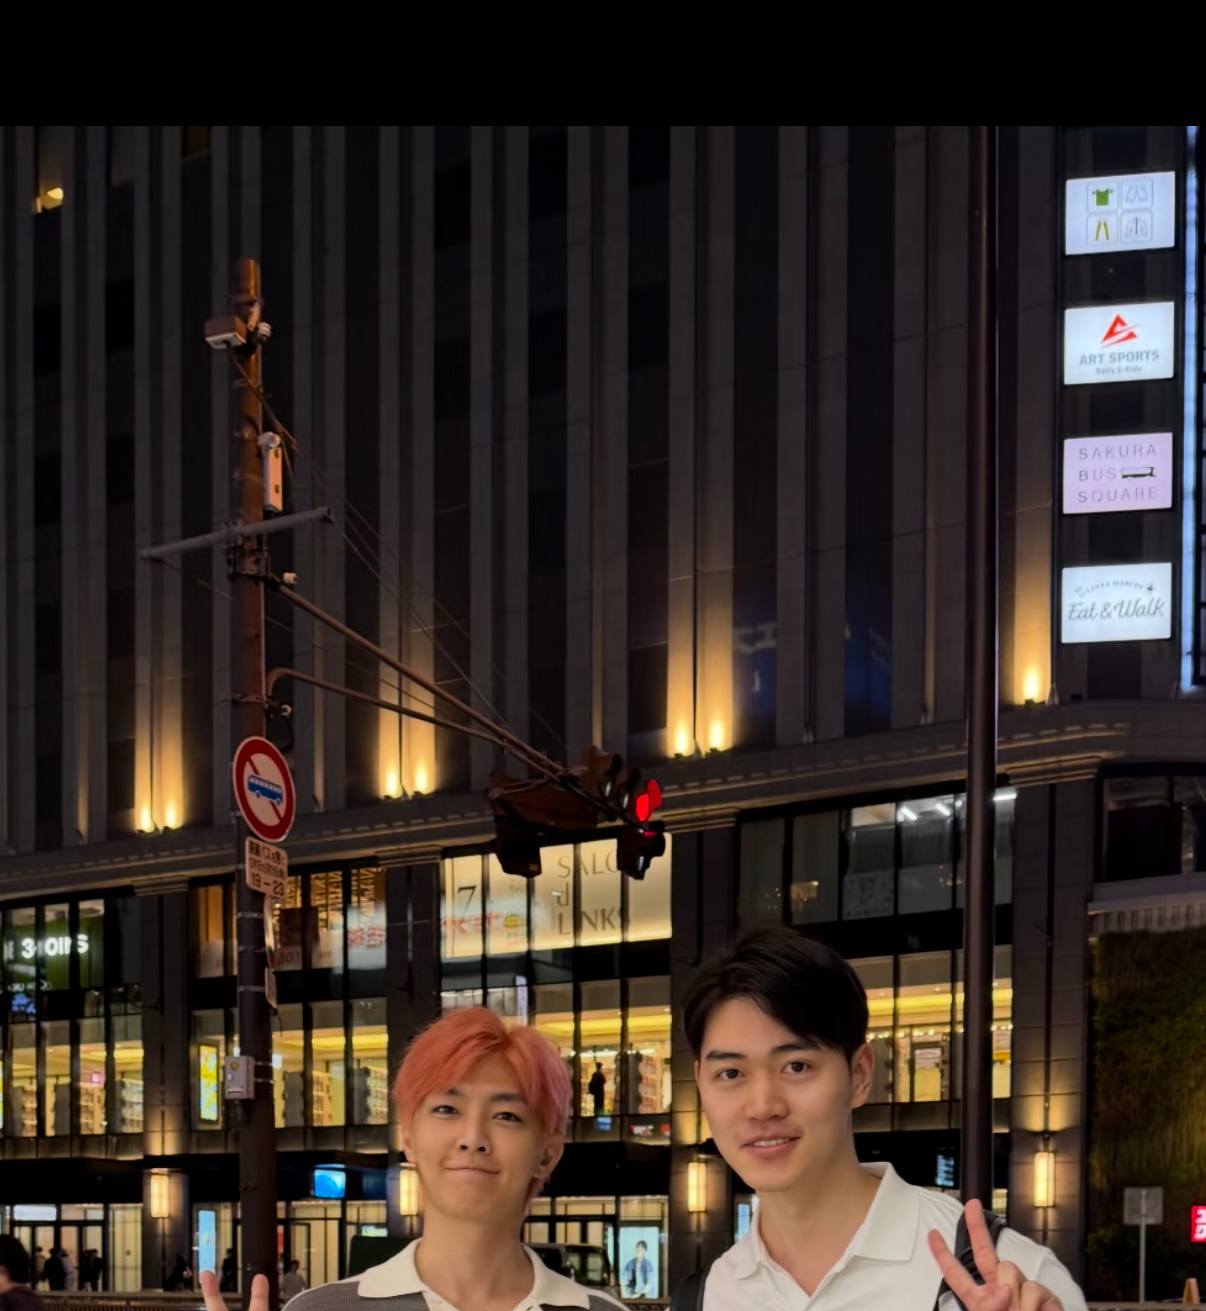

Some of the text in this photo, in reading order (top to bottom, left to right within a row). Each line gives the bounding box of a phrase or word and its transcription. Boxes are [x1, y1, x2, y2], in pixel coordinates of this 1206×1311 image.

[1079, 350, 1159, 366] ART SPORTS
[1078, 443, 1157, 461] SAKURA
[1079, 467, 1117, 482] BUS
[1078, 486, 1158, 504] SQUARE
[1068, 596, 1165, 621] Eat & Walk
[558, 850, 619, 879] SALO
[558, 908, 624, 935] LNK
[21, 934, 89, 959] 3OINS
